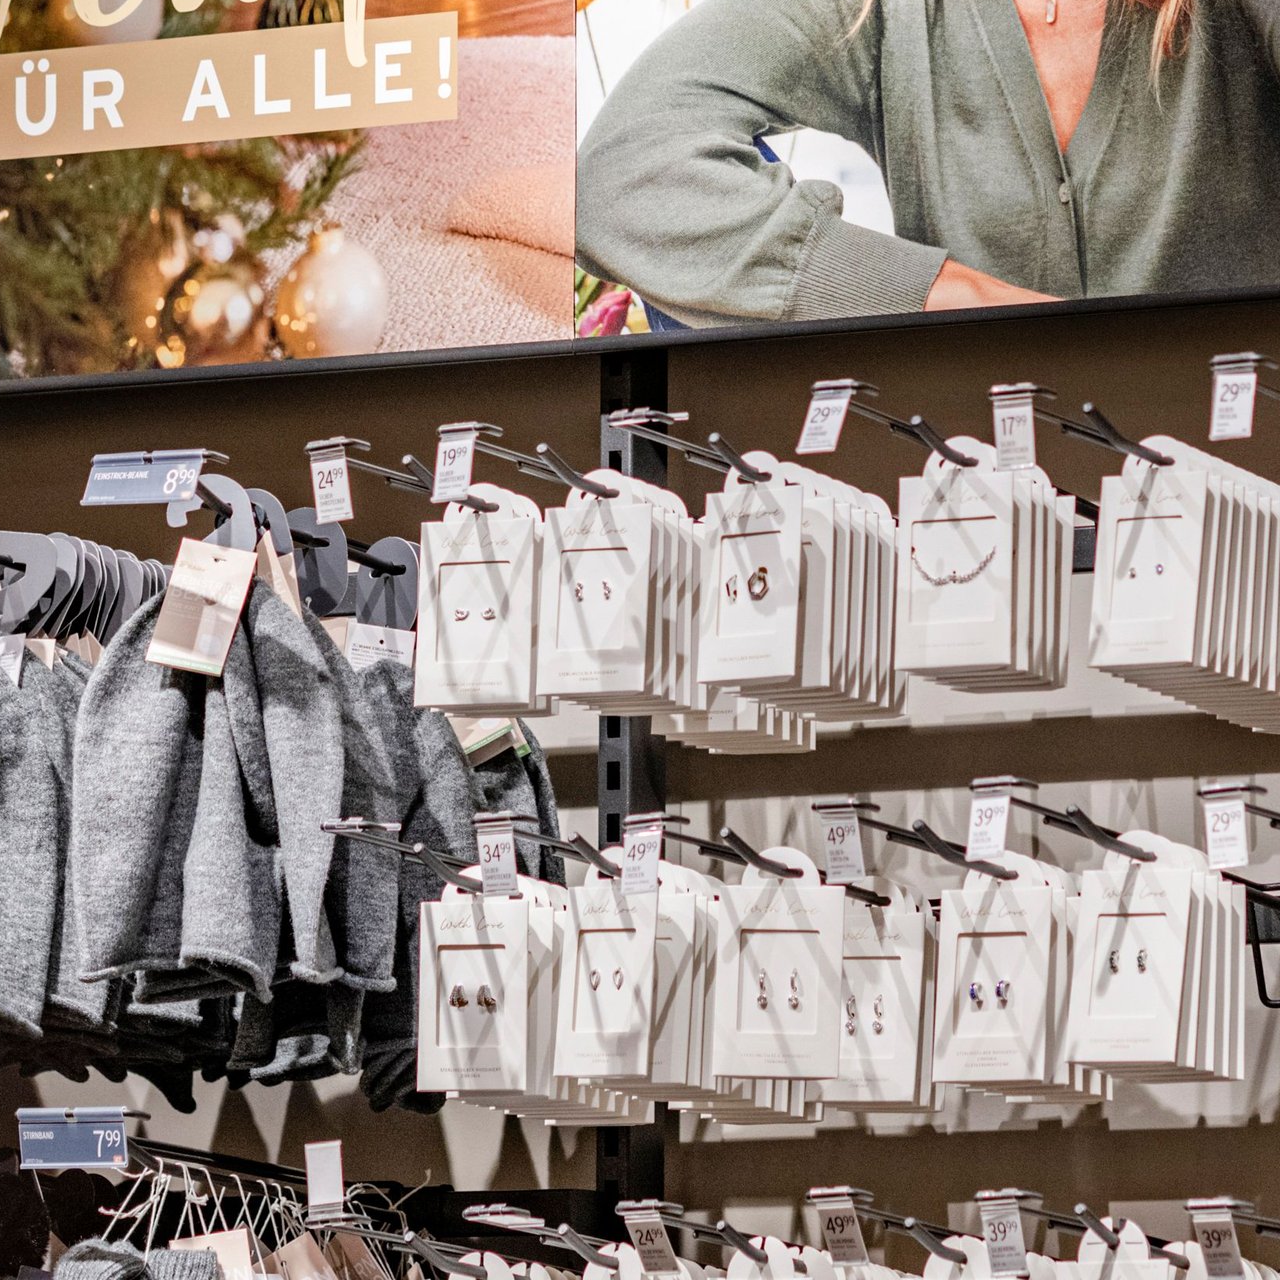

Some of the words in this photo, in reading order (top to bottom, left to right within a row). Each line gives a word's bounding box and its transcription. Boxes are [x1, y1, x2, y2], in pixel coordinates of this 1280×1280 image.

[182, 36, 453, 122] ALLE!
[439, 915, 473, 932] With
[478, 915, 506, 931] Love
[22, 1130, 55, 1141] STIRNBAND
